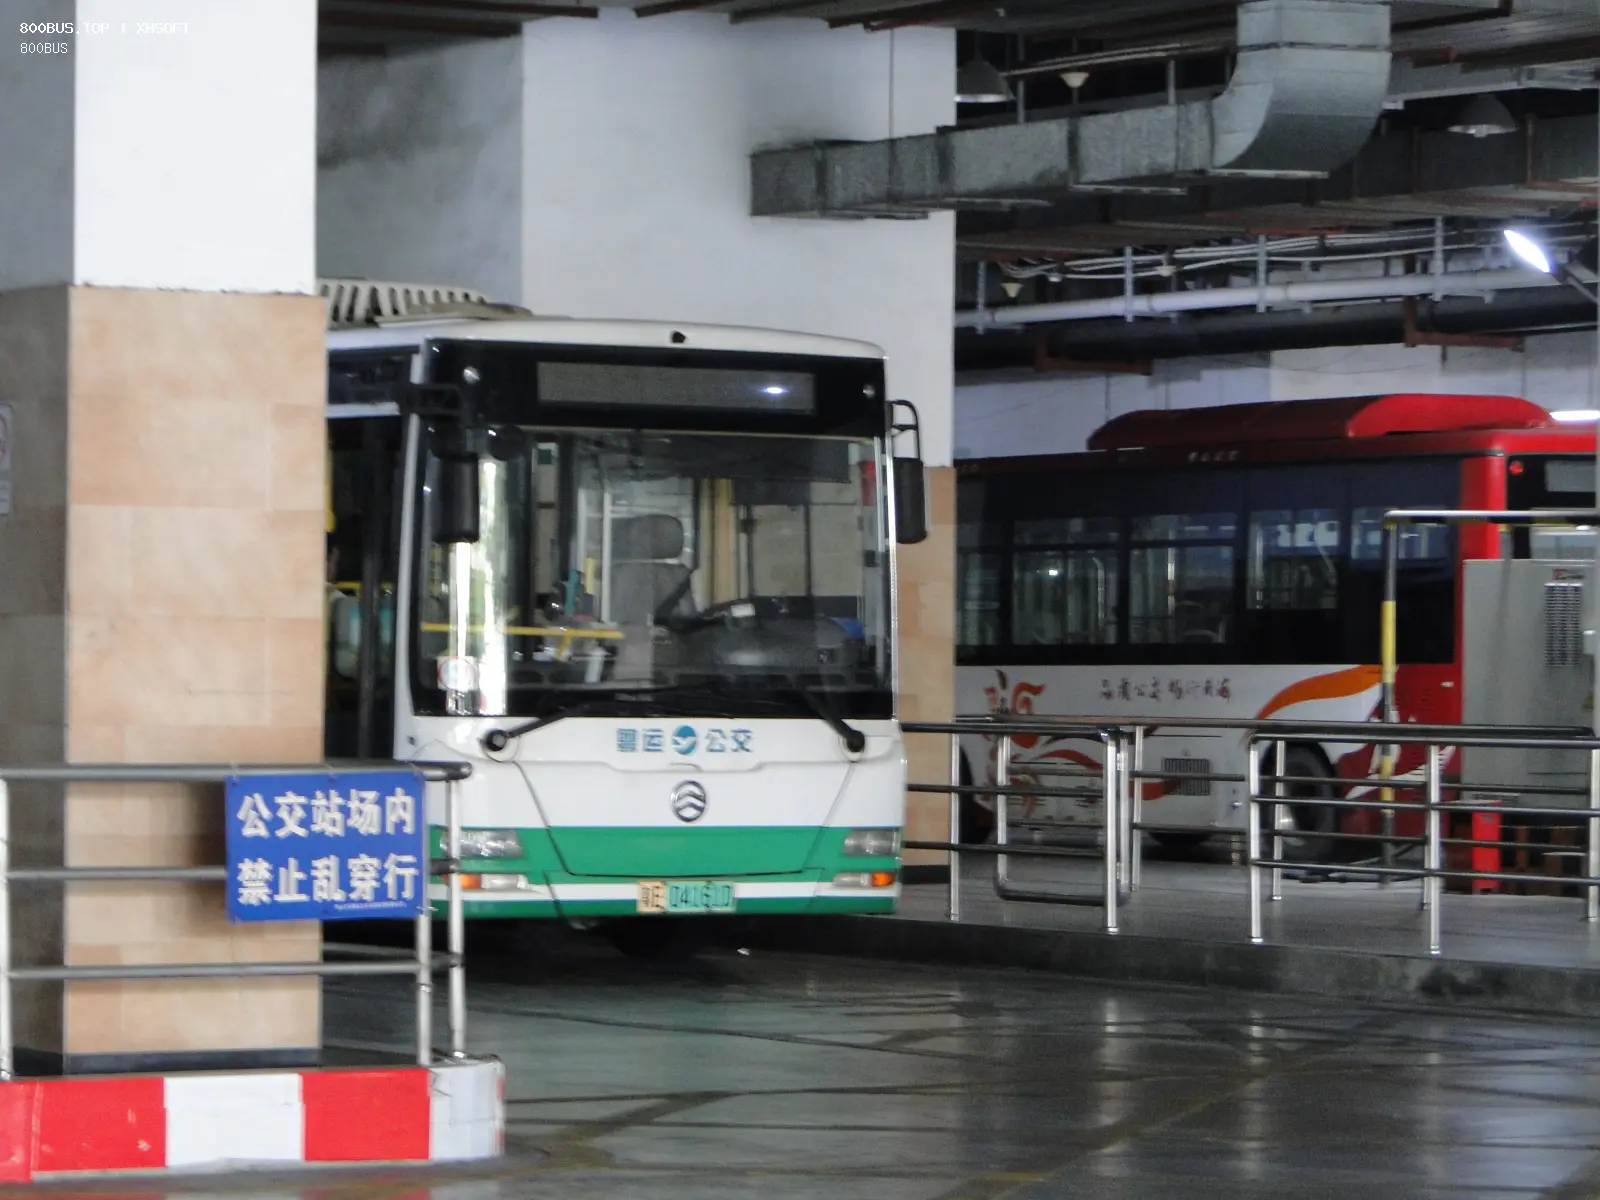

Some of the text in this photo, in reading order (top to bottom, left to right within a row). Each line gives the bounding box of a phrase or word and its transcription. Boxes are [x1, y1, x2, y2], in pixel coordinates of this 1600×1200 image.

[616, 727, 754, 753] 粤运 公交
[236, 786, 416, 839] 公交站场内
[236, 852, 419, 906] 禁止乱穿行
